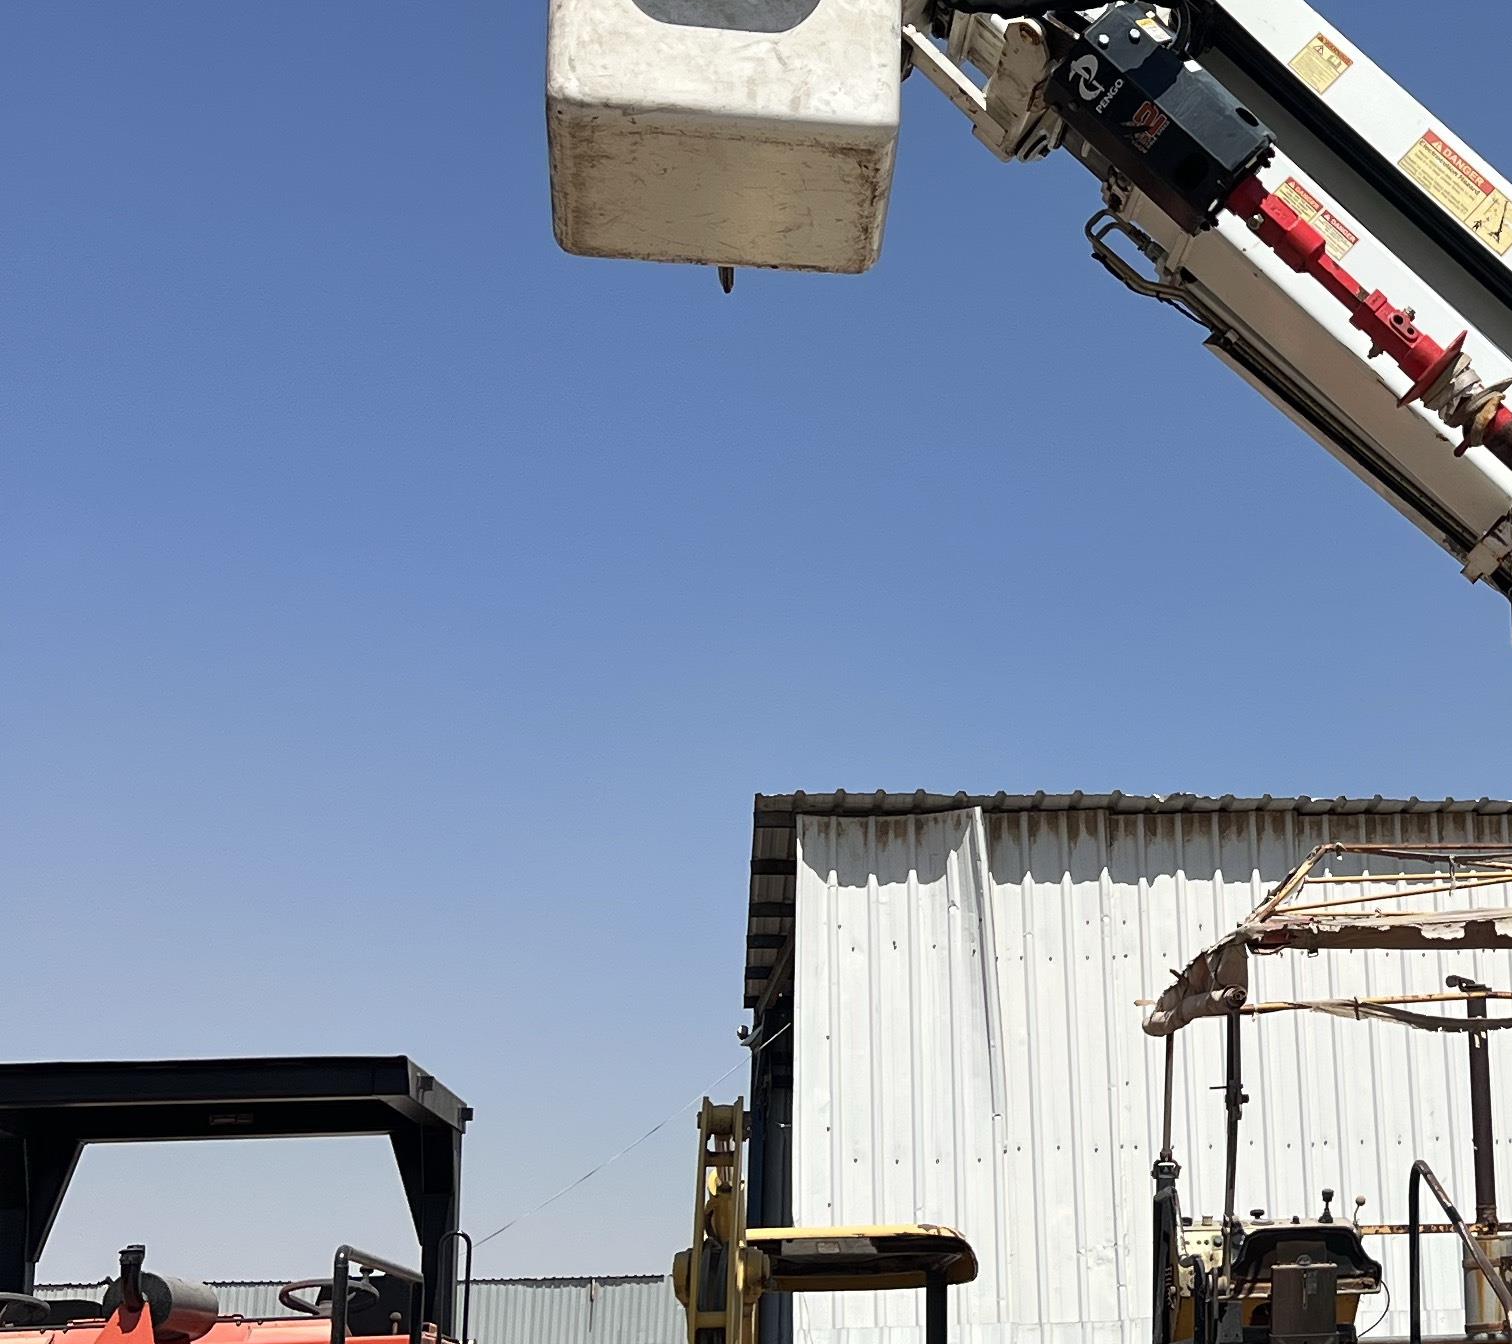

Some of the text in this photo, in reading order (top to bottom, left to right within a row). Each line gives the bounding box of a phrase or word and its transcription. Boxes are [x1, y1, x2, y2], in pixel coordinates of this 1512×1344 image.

[1095, 78, 1124, 114] PENGO
[1442, 147, 1485, 186] DANGER
[1331, 218, 1356, 242] DANGER
